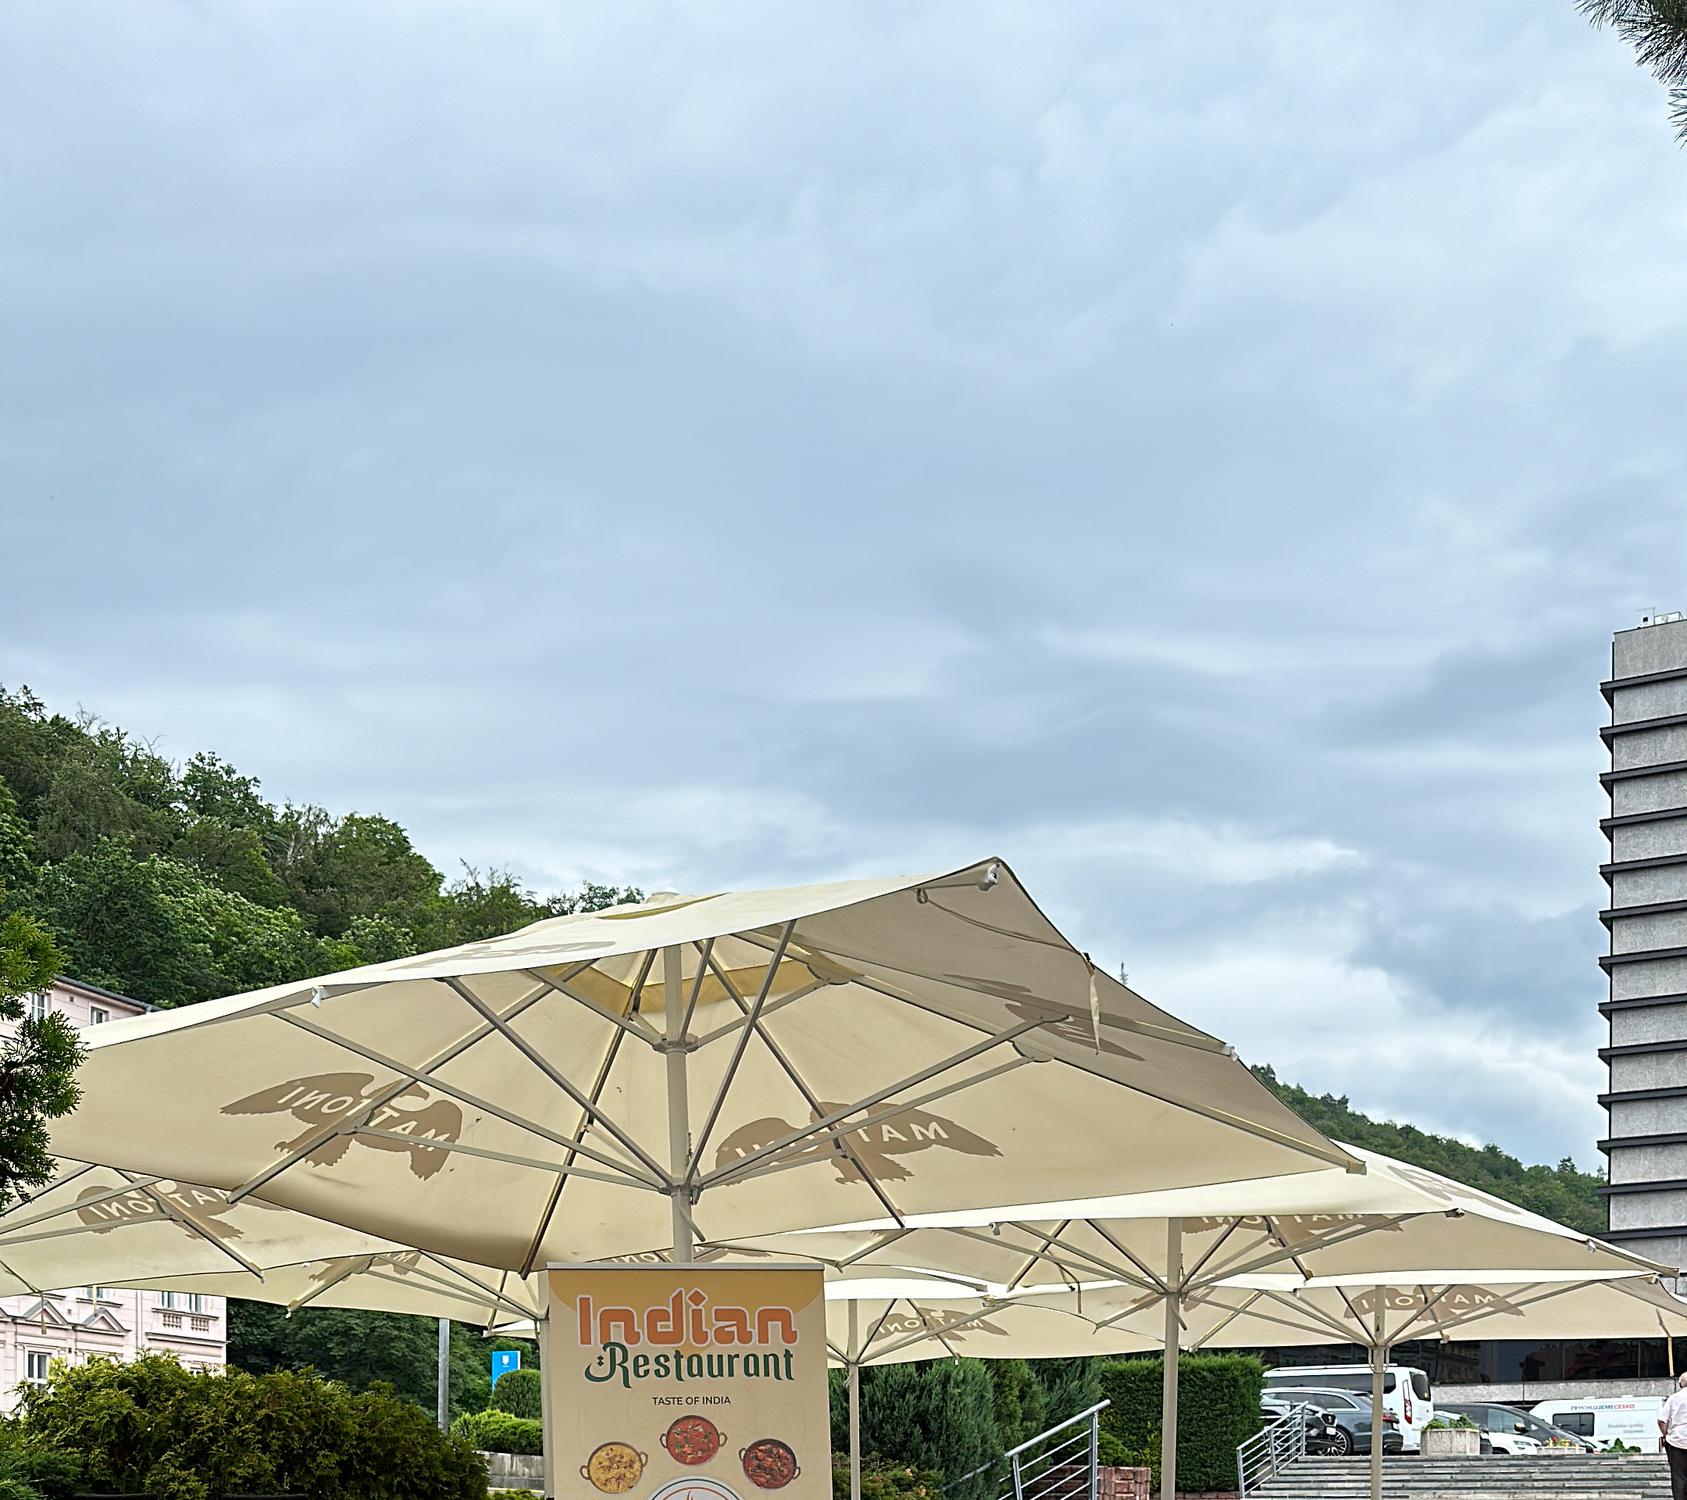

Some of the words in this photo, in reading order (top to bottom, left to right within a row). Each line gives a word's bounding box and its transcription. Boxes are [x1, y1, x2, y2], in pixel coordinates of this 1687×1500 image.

[577, 1289, 798, 1345] Indian
[584, 1342, 795, 1388] Restaurant
[652, 1396, 683, 1406] TASTE
[685, 1396, 700, 1406] OF
[702, 1396, 731, 1405] INDIA
